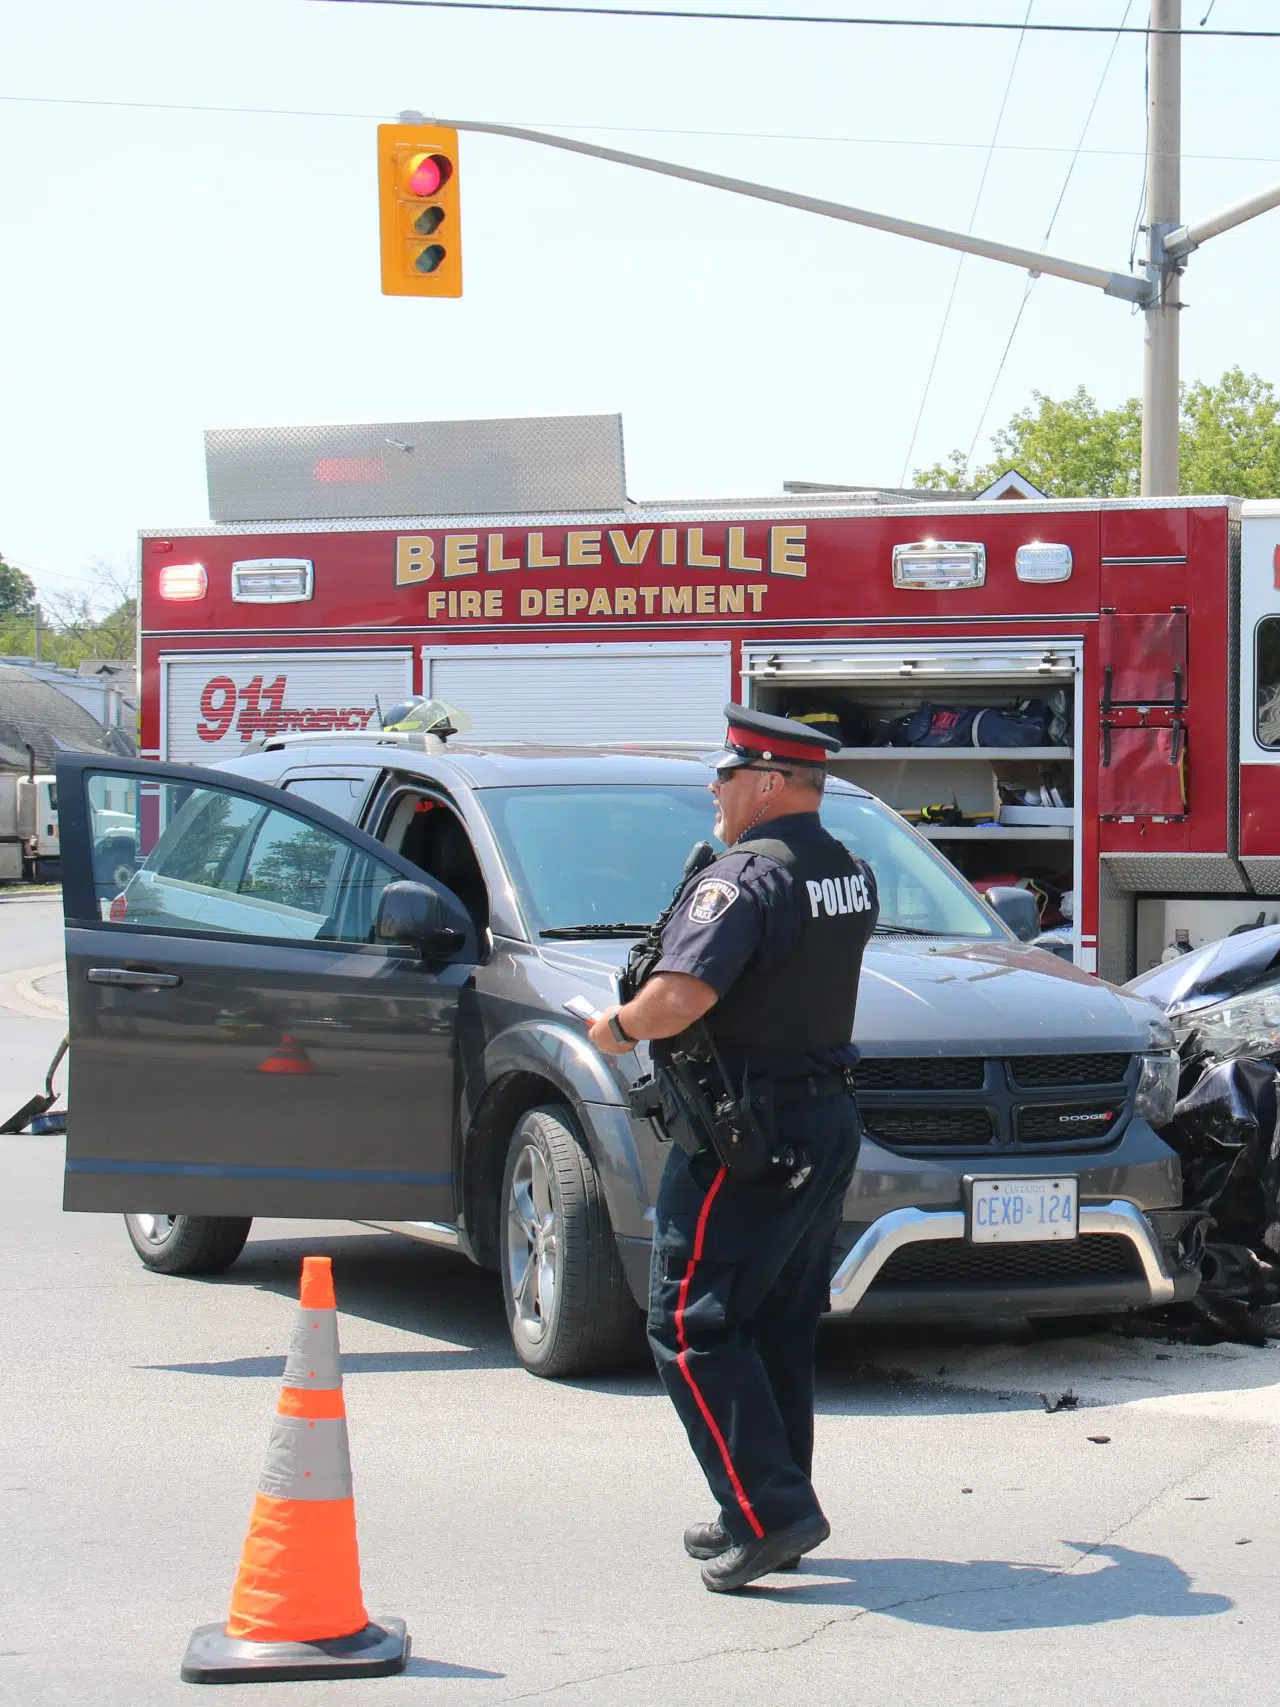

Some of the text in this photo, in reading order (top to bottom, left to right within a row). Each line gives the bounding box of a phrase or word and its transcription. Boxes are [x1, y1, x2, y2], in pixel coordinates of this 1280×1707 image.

[396, 525, 807, 586] BELLEVILLE
[428, 585, 769, 619] FIRE DEPARTMENT
[197, 675, 287, 742] 911
[806, 874, 872, 918] POLICE
[1059, 1113, 1108, 1122] DODGE
[1004, 1184, 1046, 1194] ONTARIO
[976, 1197, 1024, 1226] CEXB
